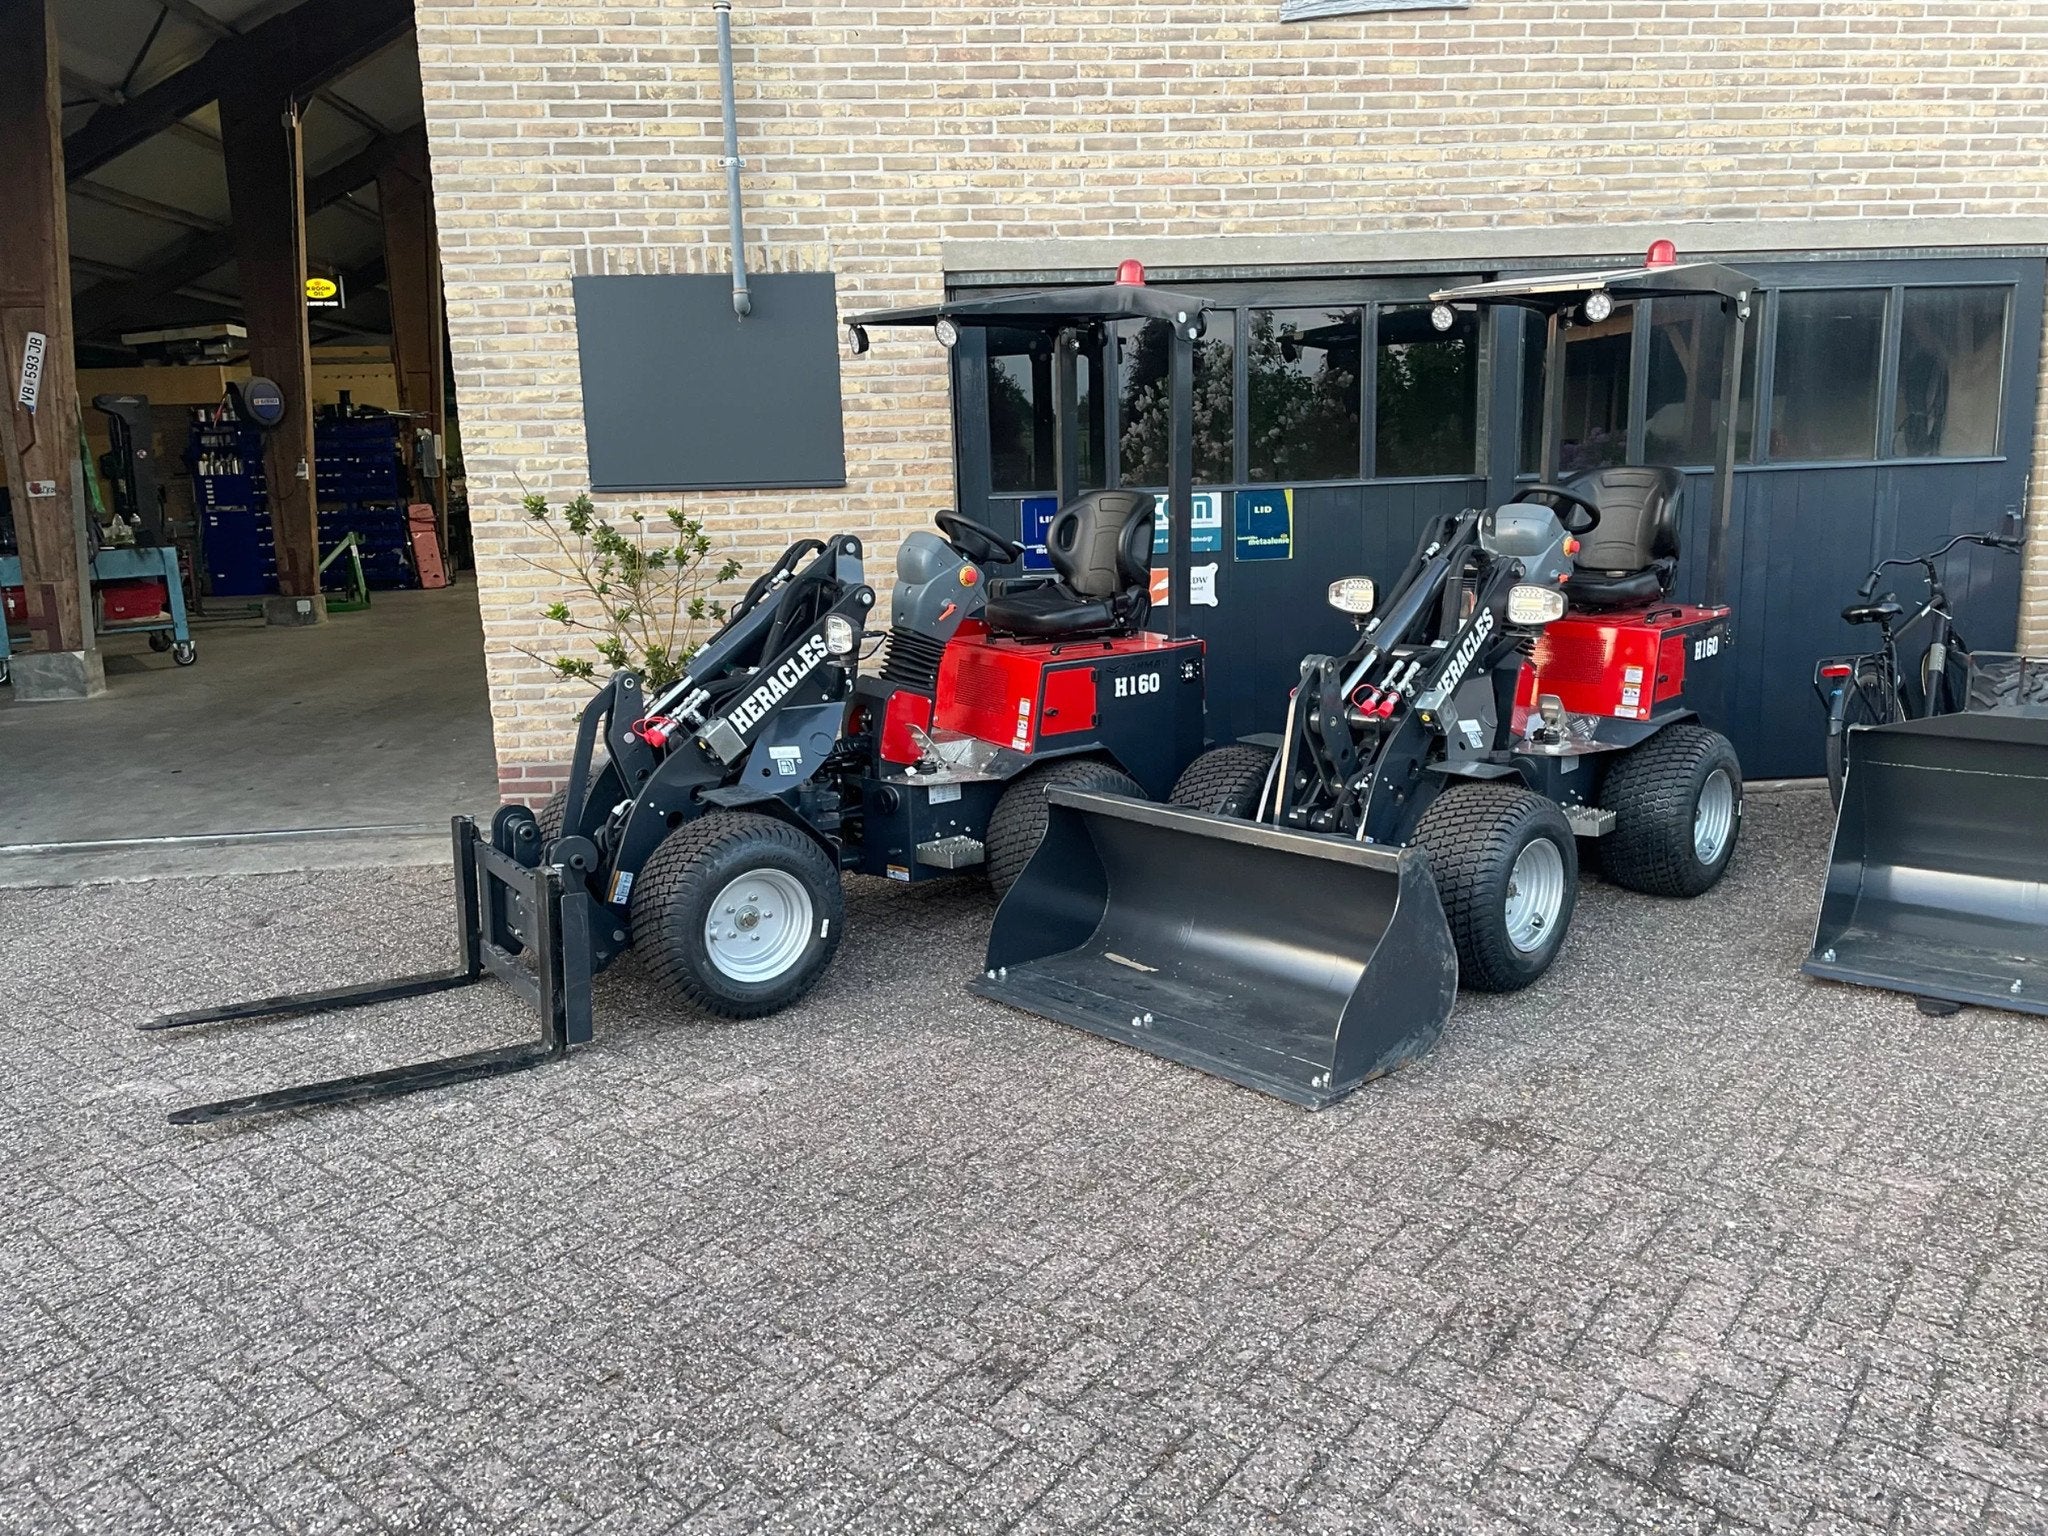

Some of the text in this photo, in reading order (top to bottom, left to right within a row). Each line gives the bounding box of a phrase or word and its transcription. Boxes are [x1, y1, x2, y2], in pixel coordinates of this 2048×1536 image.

[21, 337, 42, 401] VB 593 JB
[1253, 505, 1273, 514] LID
[1694, 635, 1719, 661] H160
[727, 634, 829, 735] HERACLES
[1114, 672, 1160, 697] H160
